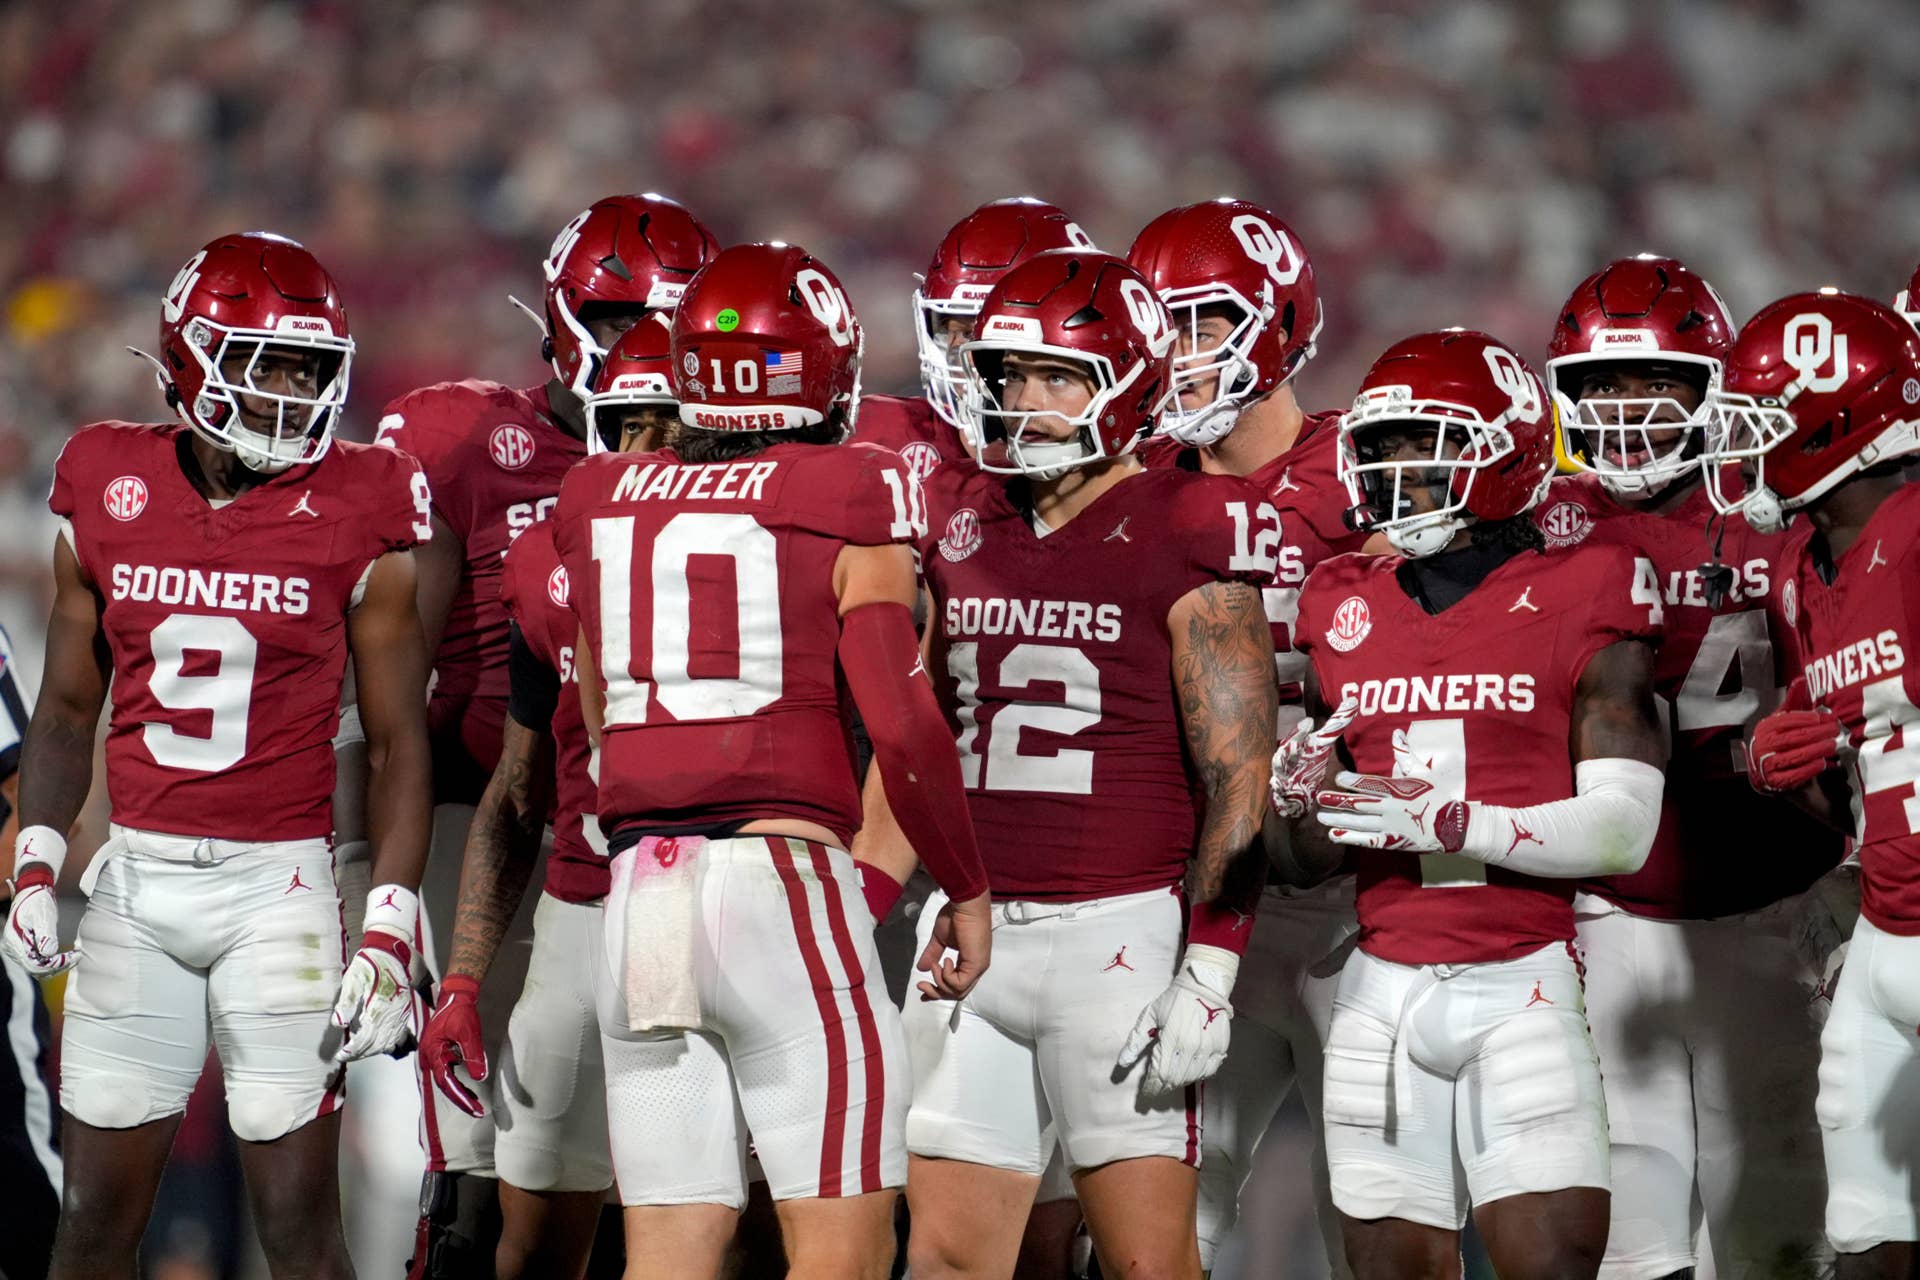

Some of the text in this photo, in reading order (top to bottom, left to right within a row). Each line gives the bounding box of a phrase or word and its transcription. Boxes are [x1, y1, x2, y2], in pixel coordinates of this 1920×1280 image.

[1230, 214, 1302, 286] OU
[292, 321, 325, 331] OKLAHOMA
[717, 314, 737, 324] C2P
[796, 268, 856, 347] OU
[1120, 278, 1172, 358] OU
[1605, 334, 1642, 343] OKLAHOMA
[1782, 312, 1849, 393] OU
[711, 359, 759, 393] 10
[1482, 345, 1542, 424] OU
[695, 412, 785, 431] SOONERS
[493, 427, 530, 466] SEC
[109, 479, 144, 517] SEC
[612, 461, 778, 502] MATEER
[881, 468, 928, 539] 10
[410, 472, 433, 540] 9
[951, 511, 977, 548] SEC
[1547, 504, 1583, 536] SEC
[1225, 501, 1283, 575] 12
[112, 563, 310, 615] SOONERS
[1631, 557, 1664, 625] 4
[591, 513, 783, 732] 10
[946, 597, 1122, 642] SOONERS
[1337, 600, 1366, 637] SEC
[142, 613, 258, 772] 9
[1341, 674, 1535, 717] SOONERS
[947, 642, 1101, 794] 12
